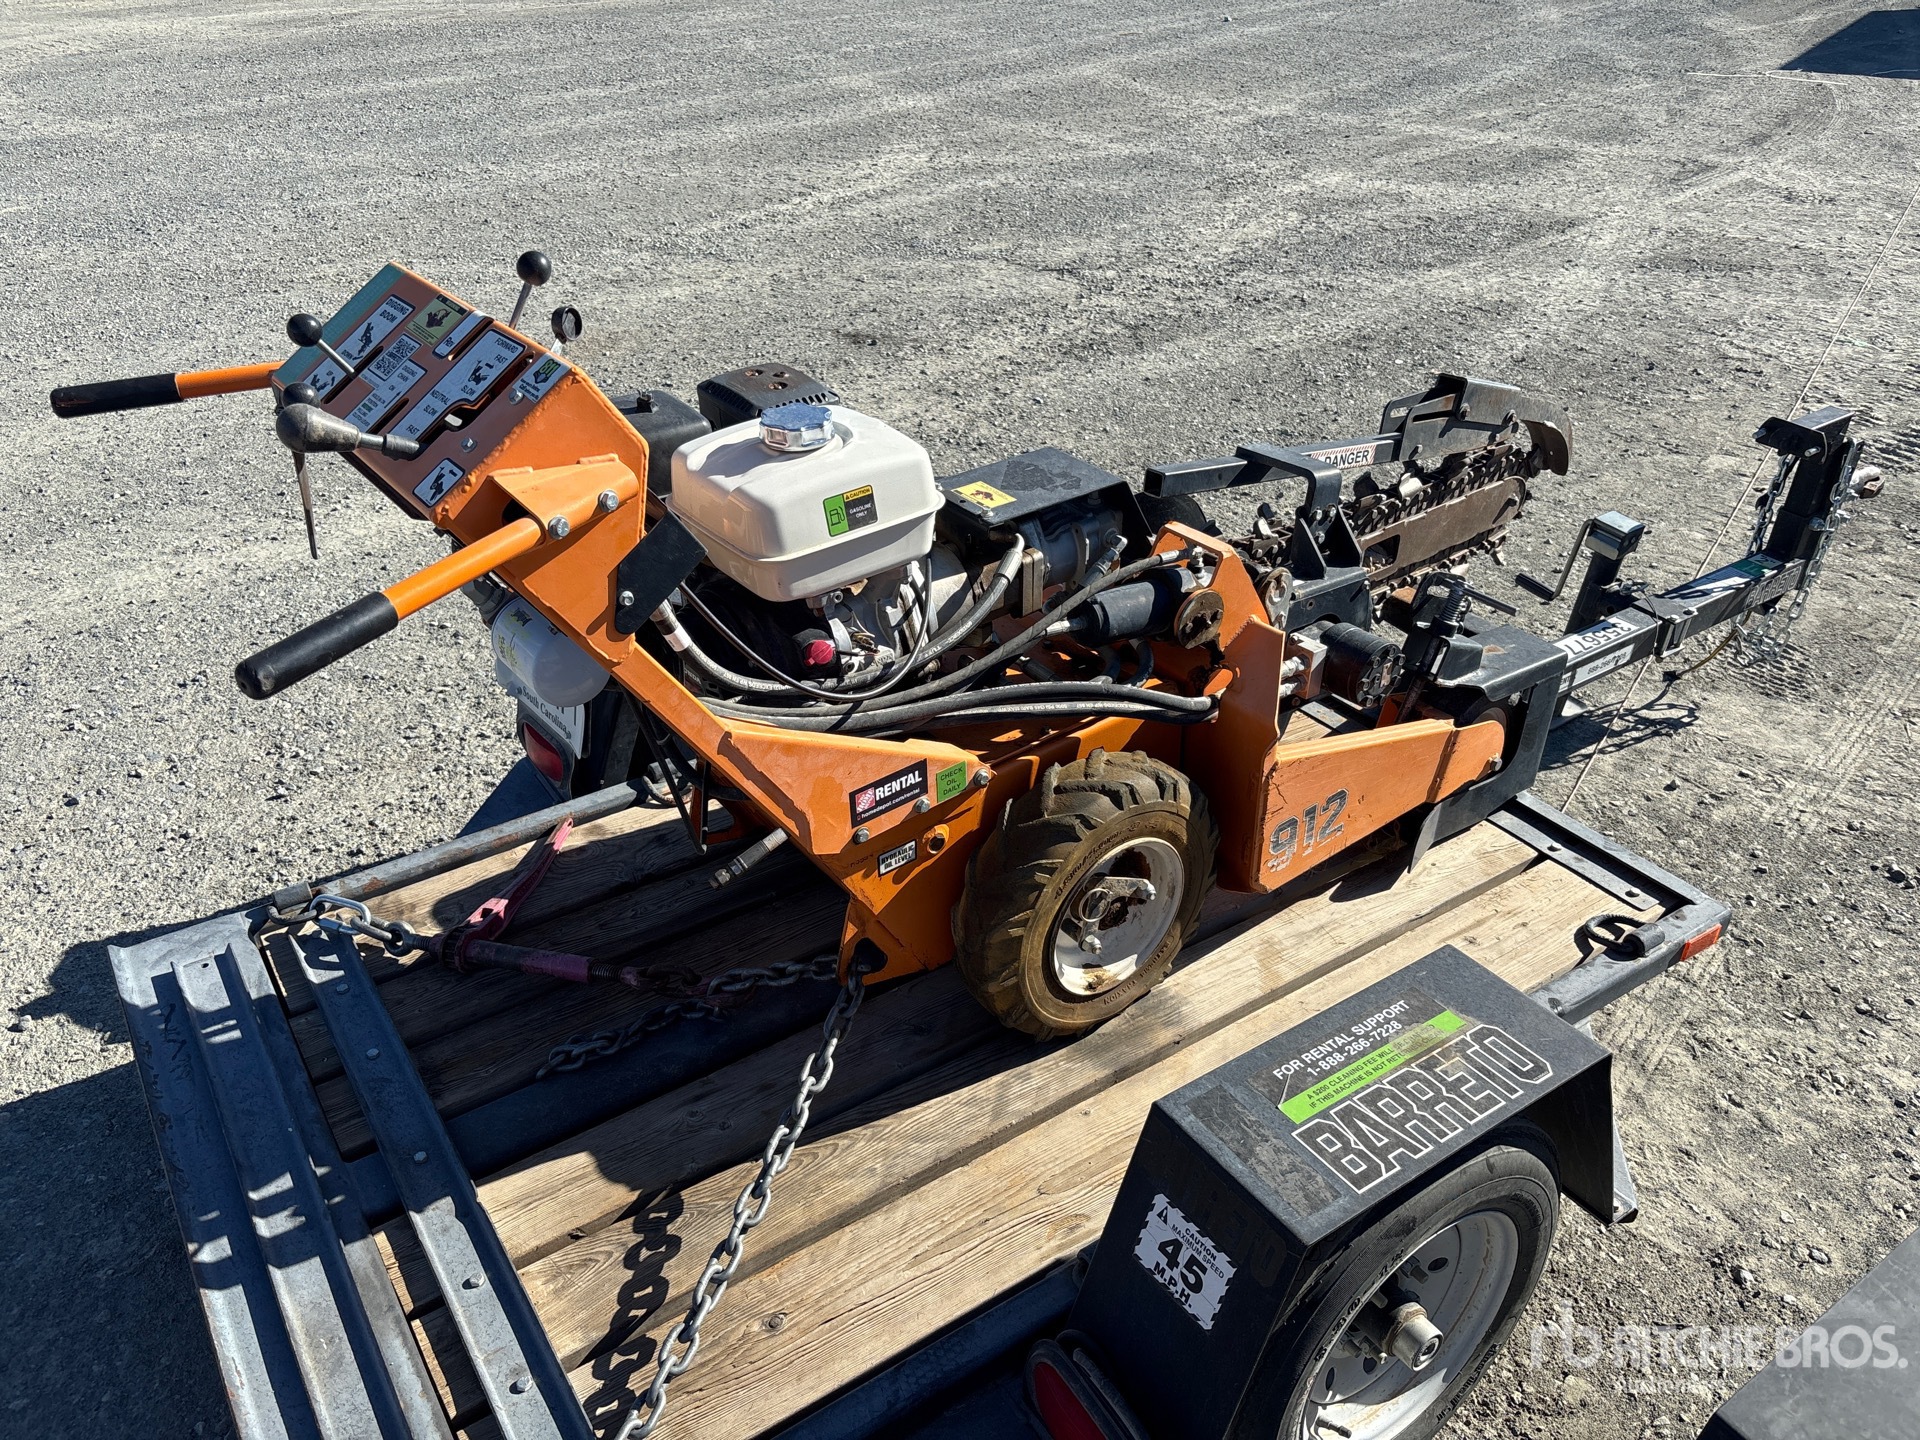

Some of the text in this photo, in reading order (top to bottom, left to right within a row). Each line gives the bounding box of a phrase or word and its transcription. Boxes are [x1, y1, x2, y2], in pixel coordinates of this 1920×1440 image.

[379, 310, 398, 323] BOOM
[386, 299, 409, 315] DIGGING
[494, 338, 519, 354] FORWARD
[493, 354, 508, 365] FAST
[430, 390, 451, 405] NEUTRAL
[460, 385, 477, 397] SLOW
[423, 404, 438, 417] SLOW
[406, 424, 420, 436] FAST
[850, 488, 871, 499] CAUTION
[849, 503, 872, 514] GASOLINE
[1564, 622, 1632, 656] 355677
[522, 687, 540, 709] South
[540, 704, 568, 734] Carolina
[875, 770, 922, 801] RENTAL
[940, 766, 963, 781] CHECK
[943, 783, 961, 796] DAILY
[1268, 788, 1349, 871] 912
[881, 843, 915, 865] HYDRAULIC
[1273, 1000, 1410, 1080] FOR RENTAL SUPPORT
[1307, 1020, 1402, 1076] 1-888-266-7228
[1310, 1100, 1317, 1109] IF
[1317, 1091, 1332, 1105] THIS
[1330, 1074, 1365, 1098] MACHINE
[1364, 1070, 1374, 1080] IS
[1373, 1062, 1388, 1076] NOT
[1386, 1043, 1421, 1064] RETURNED
[1313, 1083, 1329, 1096] $200
[1329, 1065, 1365, 1087] CLEANING
[1362, 1056, 1378, 1069] FEE
[1376, 1047, 1394, 1061] WILL
[1291, 1024, 1553, 1194] BARRETO
[1171, 1224, 1225, 1279] MAXIMUM SPEED
[1185, 1228, 1217, 1261] CAUTION
[1158, 1238, 1208, 1294] 45
[1153, 1261, 1192, 1308] M.P.H.
